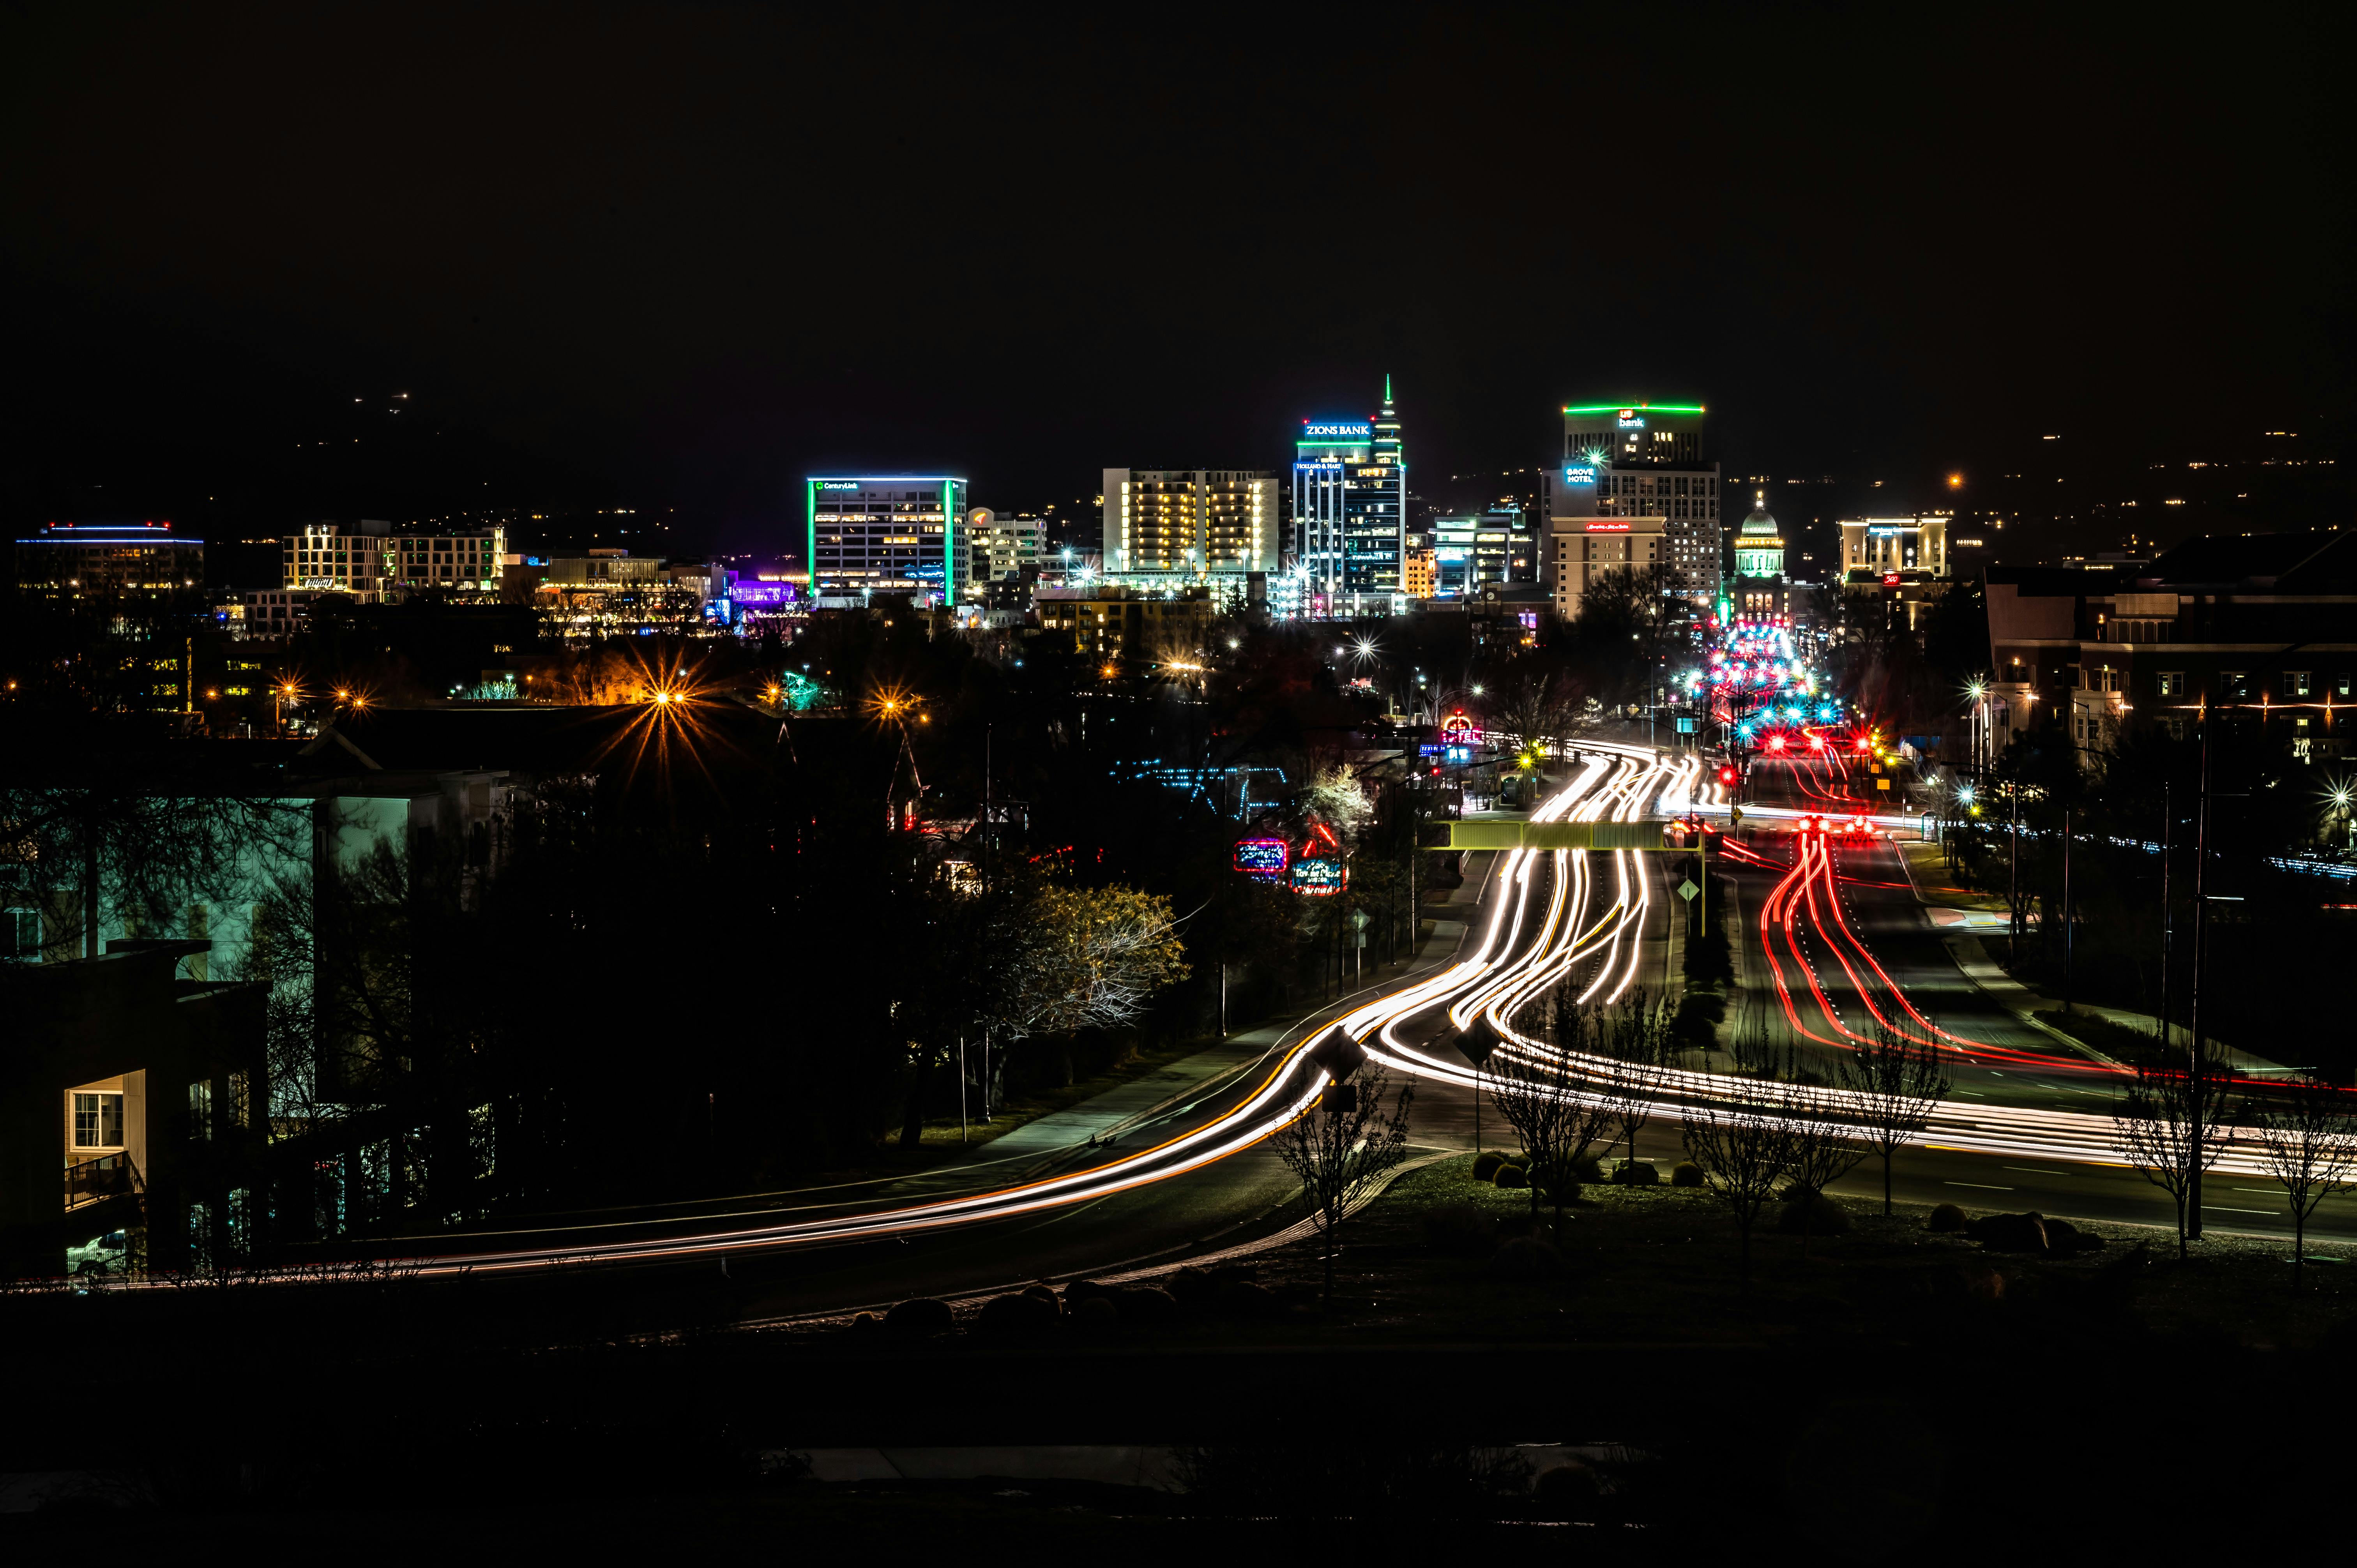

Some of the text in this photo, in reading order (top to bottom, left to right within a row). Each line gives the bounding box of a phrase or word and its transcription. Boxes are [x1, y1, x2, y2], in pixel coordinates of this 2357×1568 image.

[1619, 418, 1643, 427] bank
[1307, 426, 1369, 434] ZIONS BANK
